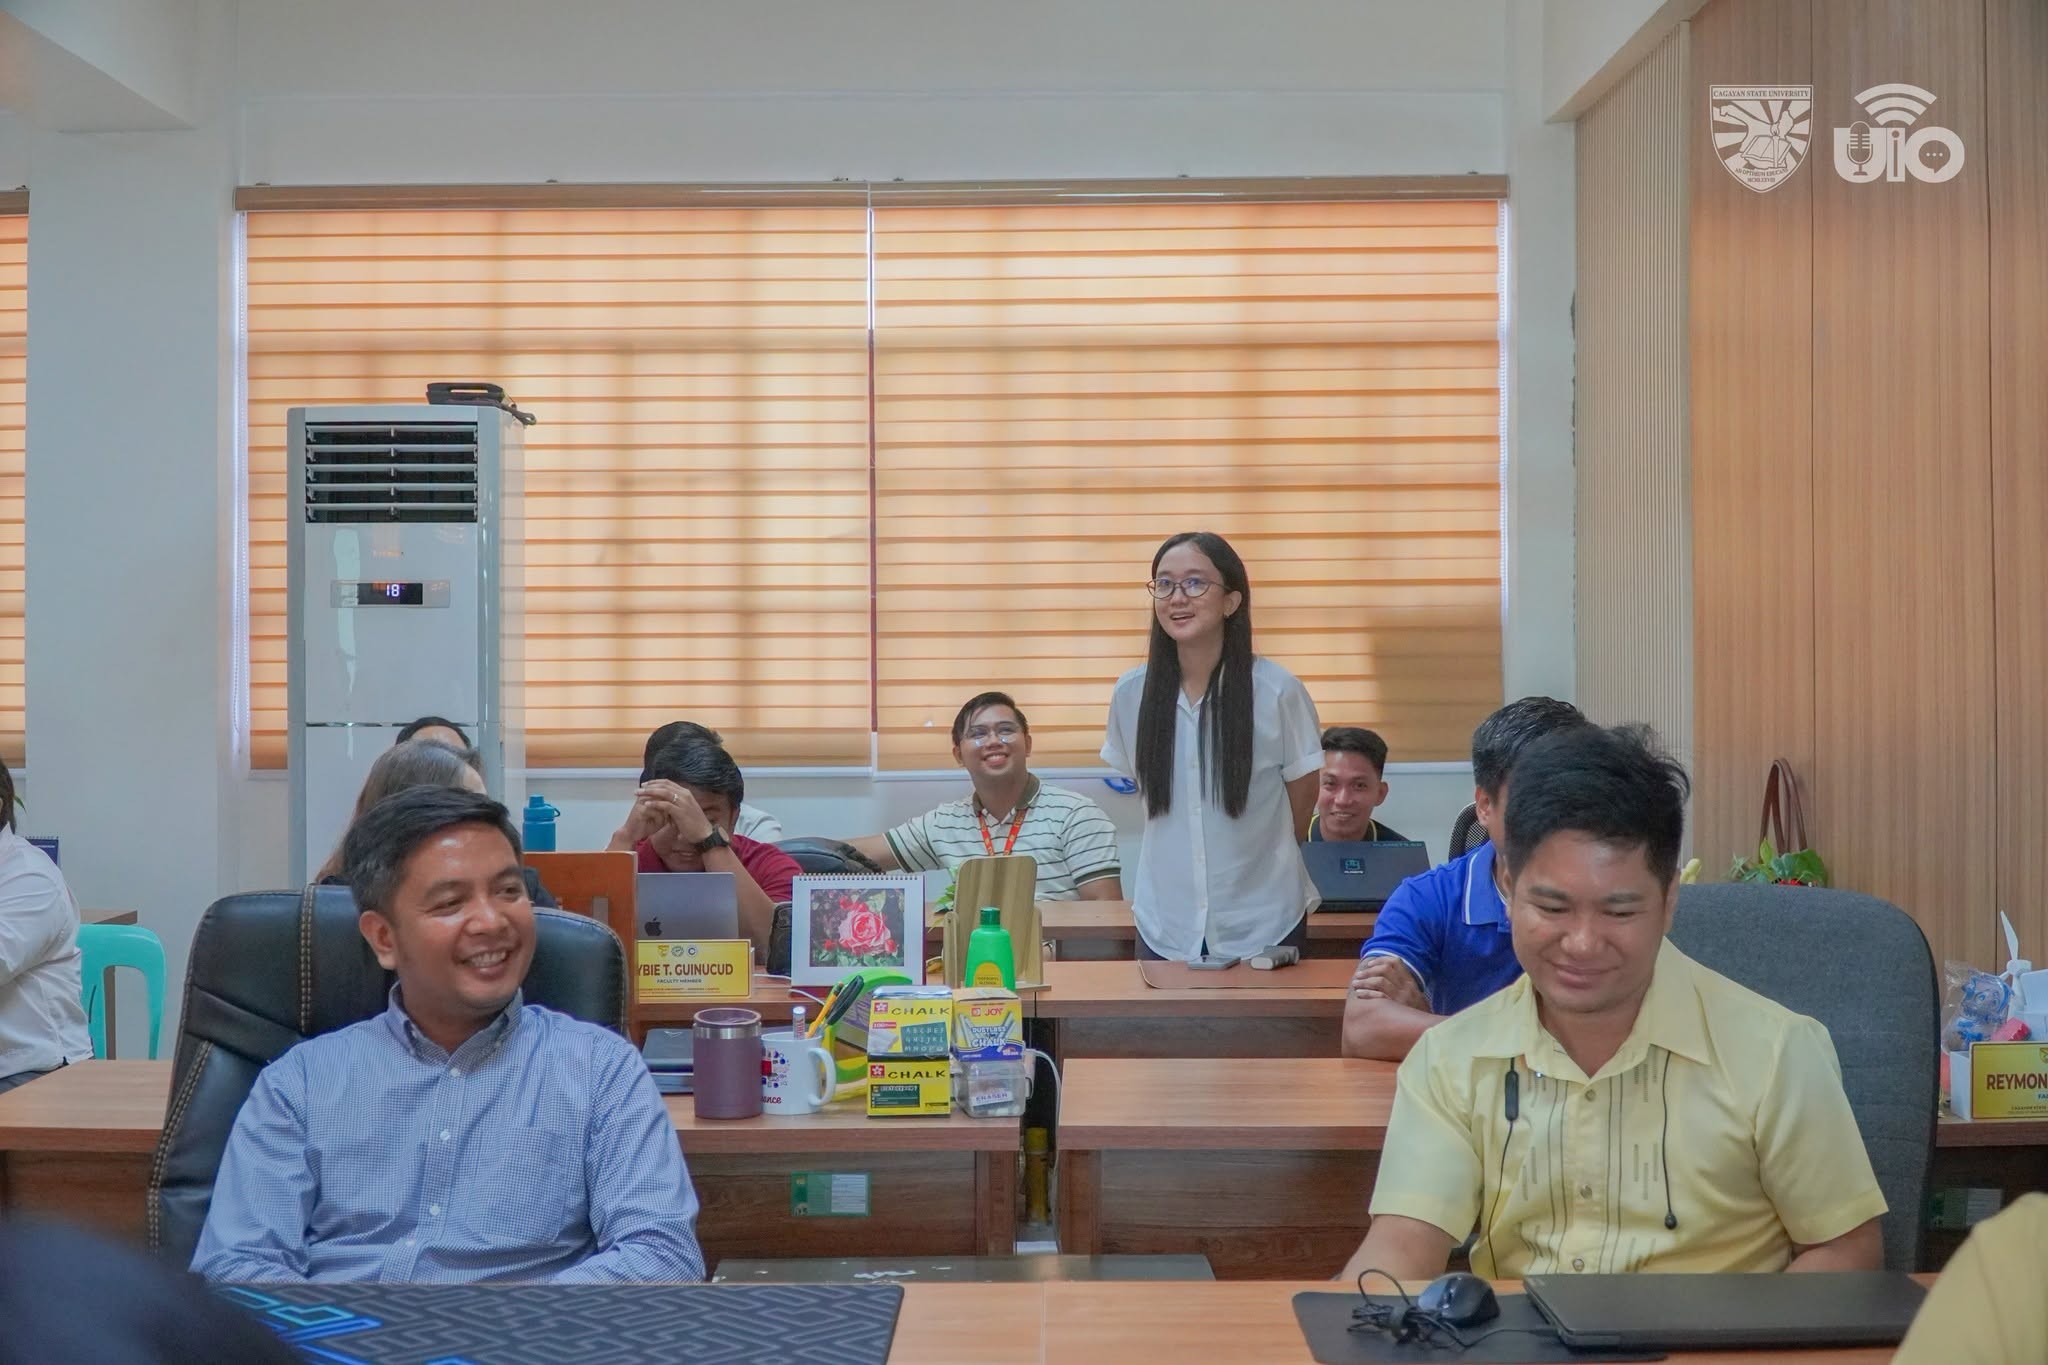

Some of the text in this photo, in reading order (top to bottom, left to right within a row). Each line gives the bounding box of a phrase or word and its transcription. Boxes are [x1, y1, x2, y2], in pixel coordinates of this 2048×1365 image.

[386, 583, 400, 597] 18
[663, 963, 672, 976] T.
[675, 963, 734, 976] GUINUCUD
[891, 1007, 950, 1016] CHALK
[984, 1007, 1004, 1016] JOY
[971, 1038, 1007, 1048] CHALK
[887, 1069, 946, 1079] CHALK
[1986, 1073, 2048, 1090] REYMON
